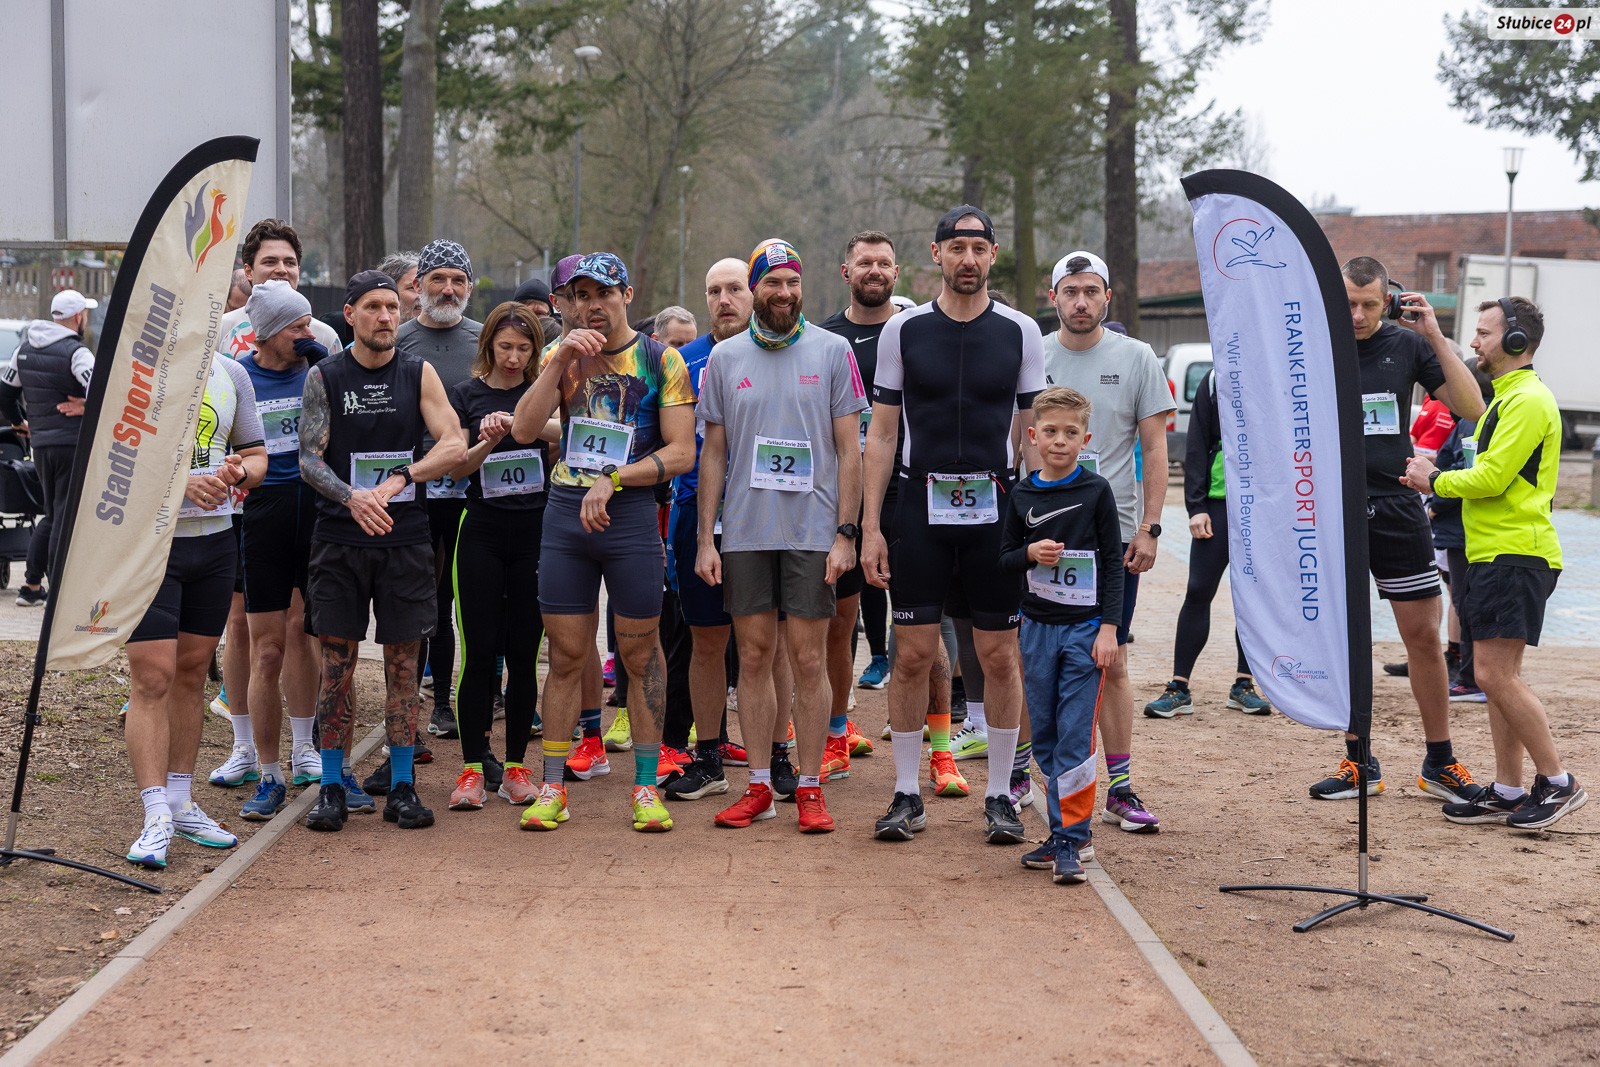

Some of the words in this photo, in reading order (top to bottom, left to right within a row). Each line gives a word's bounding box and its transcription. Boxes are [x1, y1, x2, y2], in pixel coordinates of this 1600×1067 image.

[1226, 332, 1241, 366] "Wir
[151, 355, 171, 422] FRANKFURT
[166, 318, 181, 356] (ODER)
[190, 385, 201, 399] in
[1229, 370, 1247, 428] bringen
[95, 282, 177, 526] StadtSportBund
[580, 418, 612, 429] Parklauf-Serie
[612, 424, 625, 432] 2026
[582, 434, 607, 454] 41
[766, 439, 797, 448] Parklauf-Serie
[1237, 433, 1253, 471] euch
[769, 454, 796, 475] 32
[1284, 301, 1319, 622] FRANKFURTERSPORTJUGEND
[500, 466, 526, 485] 40
[1240, 476, 1254, 489] in
[950, 489, 977, 508] 85
[1049, 565, 1077, 587] 16
